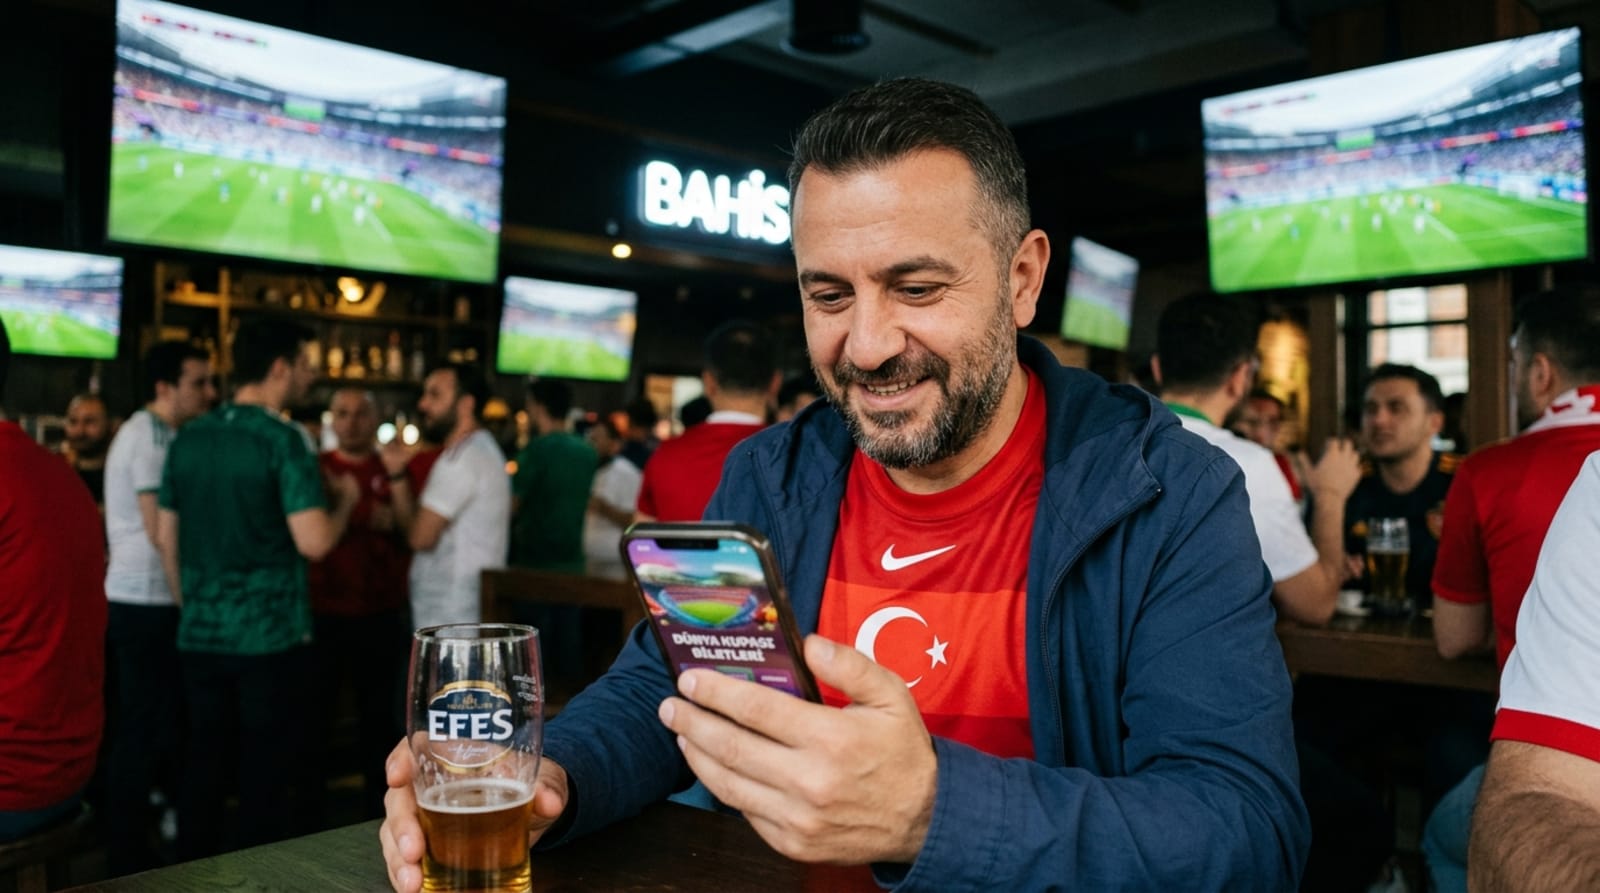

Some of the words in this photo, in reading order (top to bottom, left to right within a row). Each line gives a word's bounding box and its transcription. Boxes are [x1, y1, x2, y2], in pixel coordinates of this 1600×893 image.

[640, 159, 791, 245] BAHİS
[671, 631, 720, 646] DÜNYA
[719, 635, 776, 649] KUPASI
[691, 646, 766, 662] BİLETLERİ
[428, 708, 514, 741] EFES
